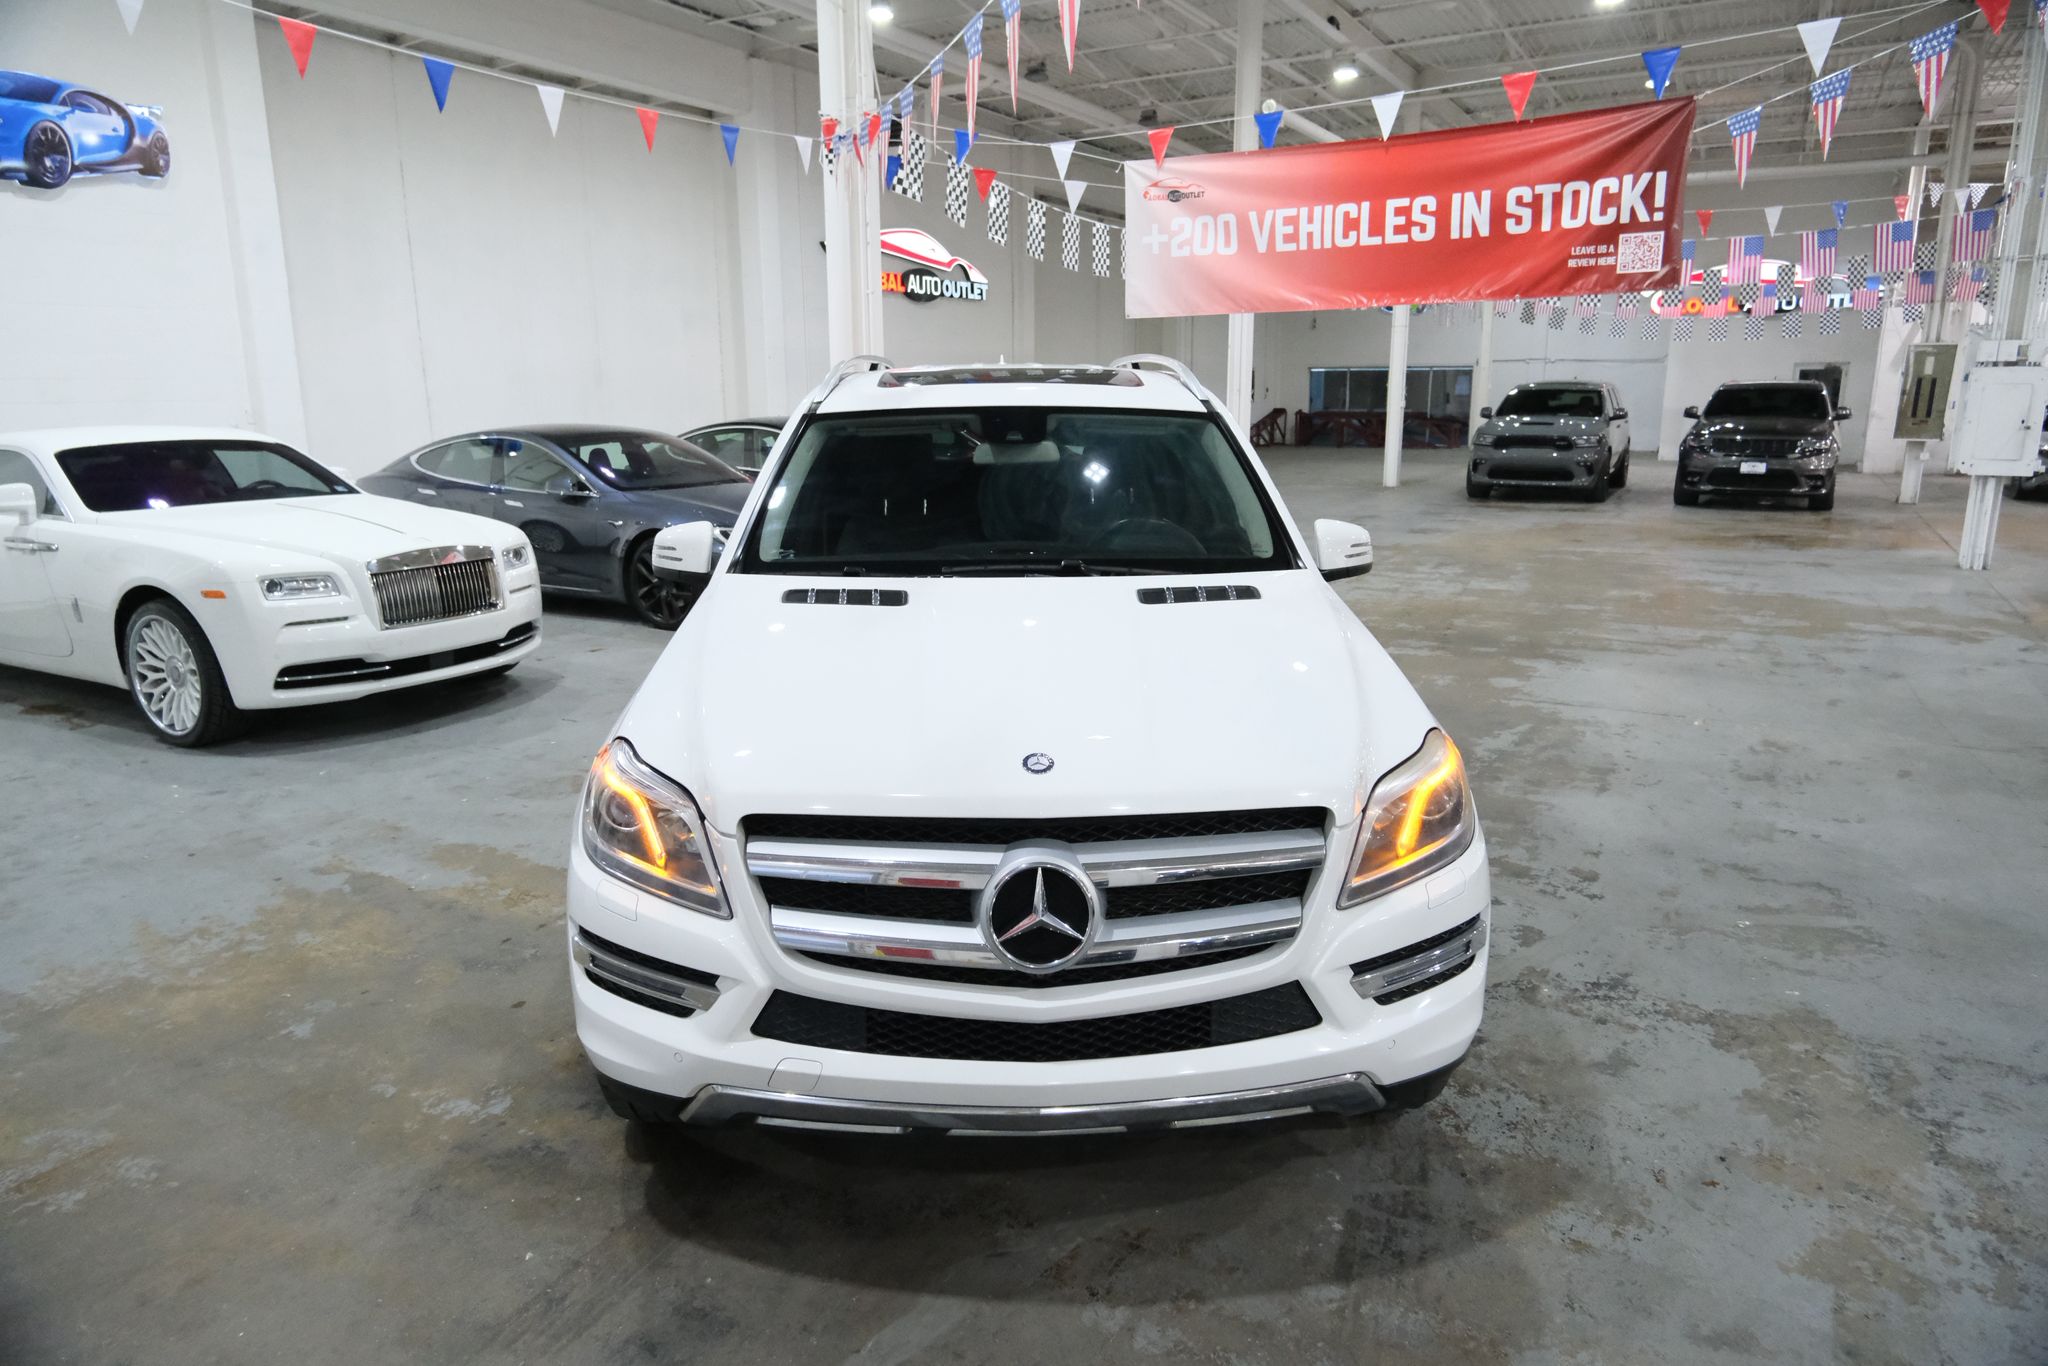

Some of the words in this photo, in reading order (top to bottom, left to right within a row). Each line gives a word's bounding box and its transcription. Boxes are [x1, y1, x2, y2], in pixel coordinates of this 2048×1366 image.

[1181, 190, 1205, 200] OUTLET
[1142, 213, 1238, 257] +200
[1249, 195, 1437, 253] VEHICLES
[1450, 189, 1491, 240] IN
[1505, 170, 1668, 235] STOCK!
[1571, 245, 1596, 256] LEAVE
[1597, 244, 1607, 254] US
[1608, 244, 1615, 253] A
[1568, 258, 1597, 268] REVIEW
[1597, 256, 1617, 266] HERE
[881, 271, 906, 293] BAL
[907, 274, 942, 296] AUTO
[942, 279, 989, 301] OUTLET
